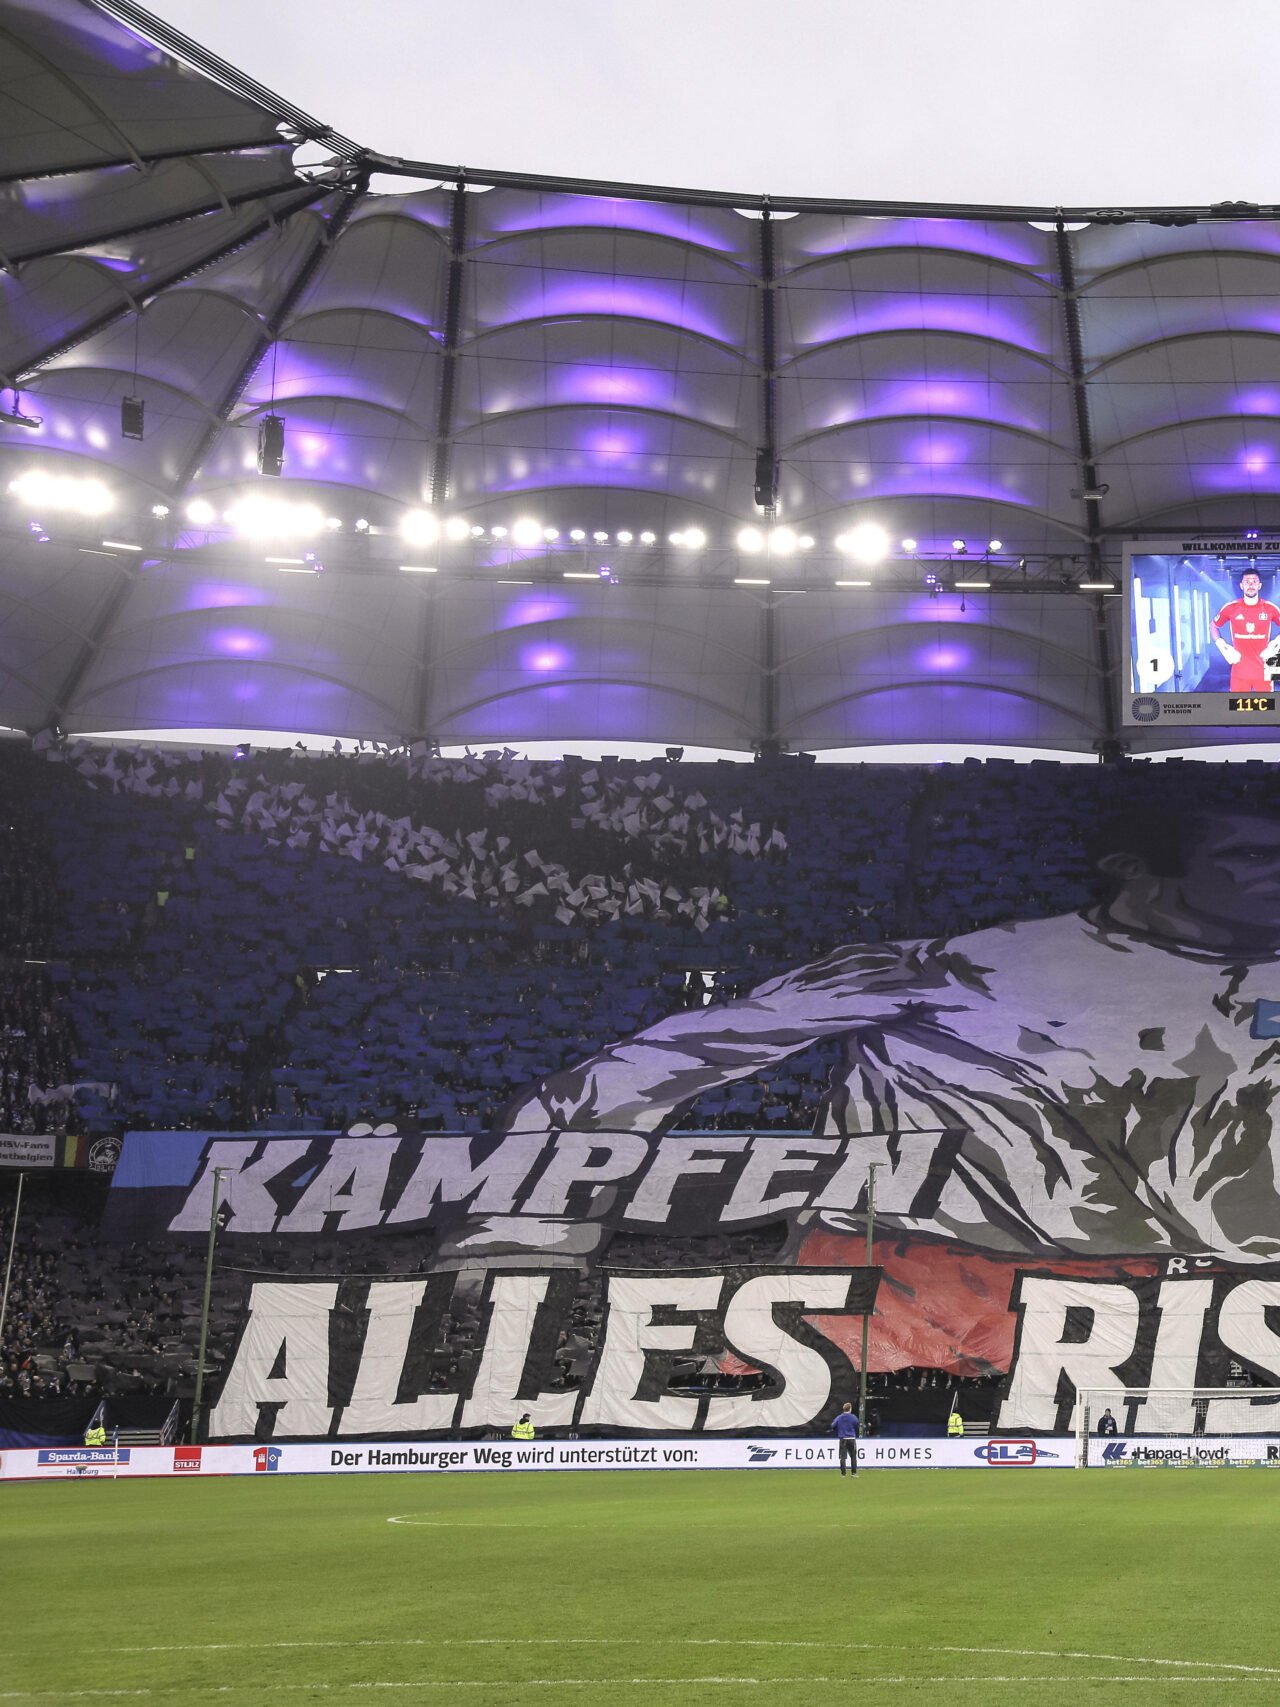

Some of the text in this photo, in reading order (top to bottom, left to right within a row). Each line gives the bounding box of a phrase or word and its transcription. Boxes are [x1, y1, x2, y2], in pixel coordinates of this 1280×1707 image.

[1182, 542, 1262, 551] WILLKOMMEN
[1150, 658, 1158, 672] 1
[1236, 698, 1268, 711] 11°C
[0, 1140, 50, 1150] HSV-Fans
[0, 1152, 53, 1162] stbelgien
[167, 1122, 943, 1233] KÄMPFEN
[208, 1274, 853, 1437] ALLES
[47, 1451, 120, 1463] Sparda-Bank
[331, 1445, 698, 1468] Der Hamburger Weg wird unterstützt von:
[785, 1447, 932, 1460] FLOATG HOMES
[175, 1461, 200, 1469] STULZ
